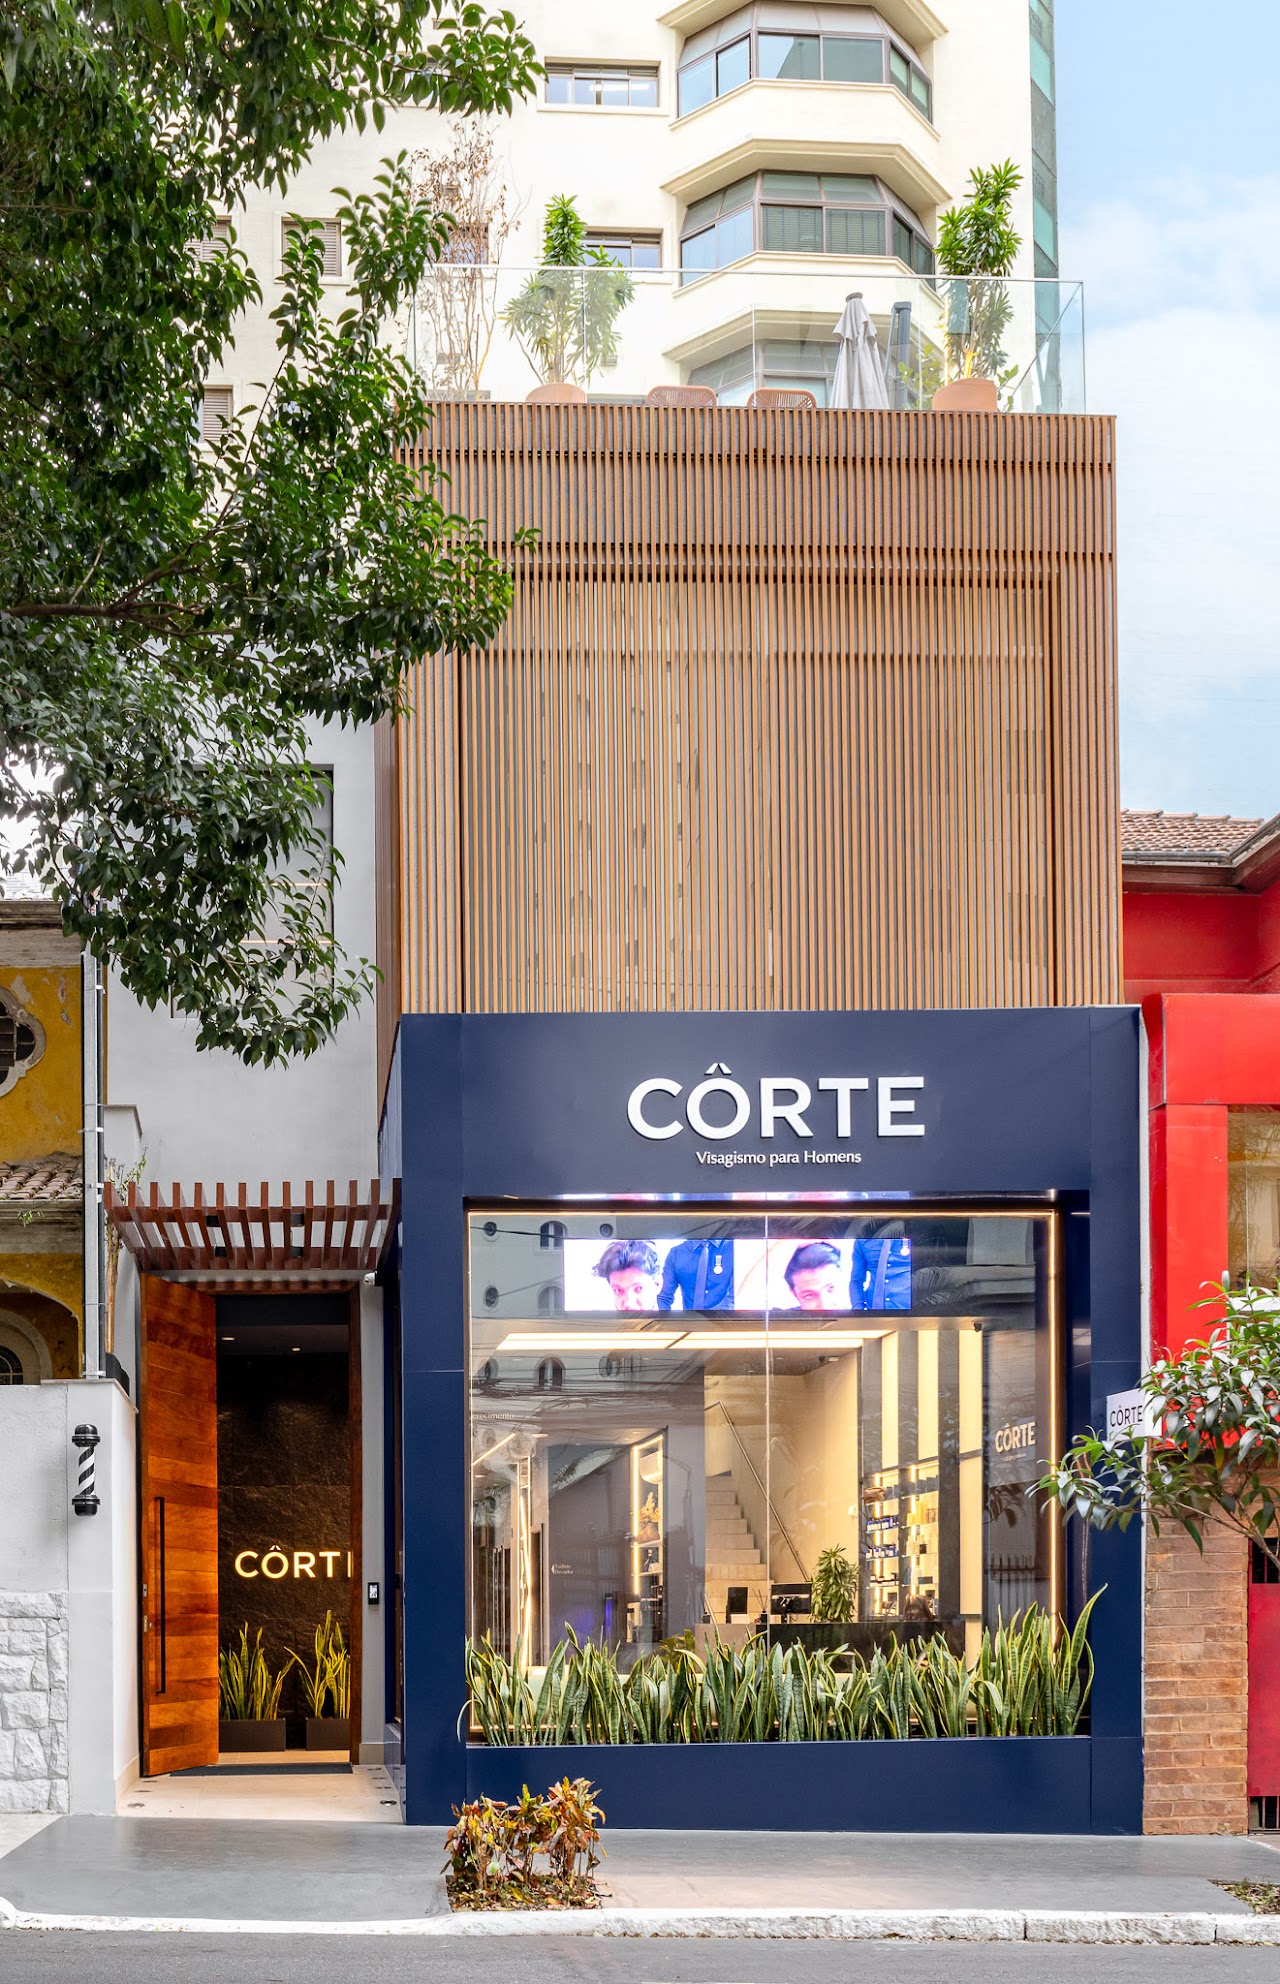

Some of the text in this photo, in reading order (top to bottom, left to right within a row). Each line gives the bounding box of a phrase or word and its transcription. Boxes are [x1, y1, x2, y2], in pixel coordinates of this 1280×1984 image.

[627, 1062, 926, 1140] CÔRTE
[695, 1150, 862, 1168] Visagismo para Homens
[1109, 1404, 1144, 1428] CÔRTE
[994, 1421, 1037, 1453] CÔRTE
